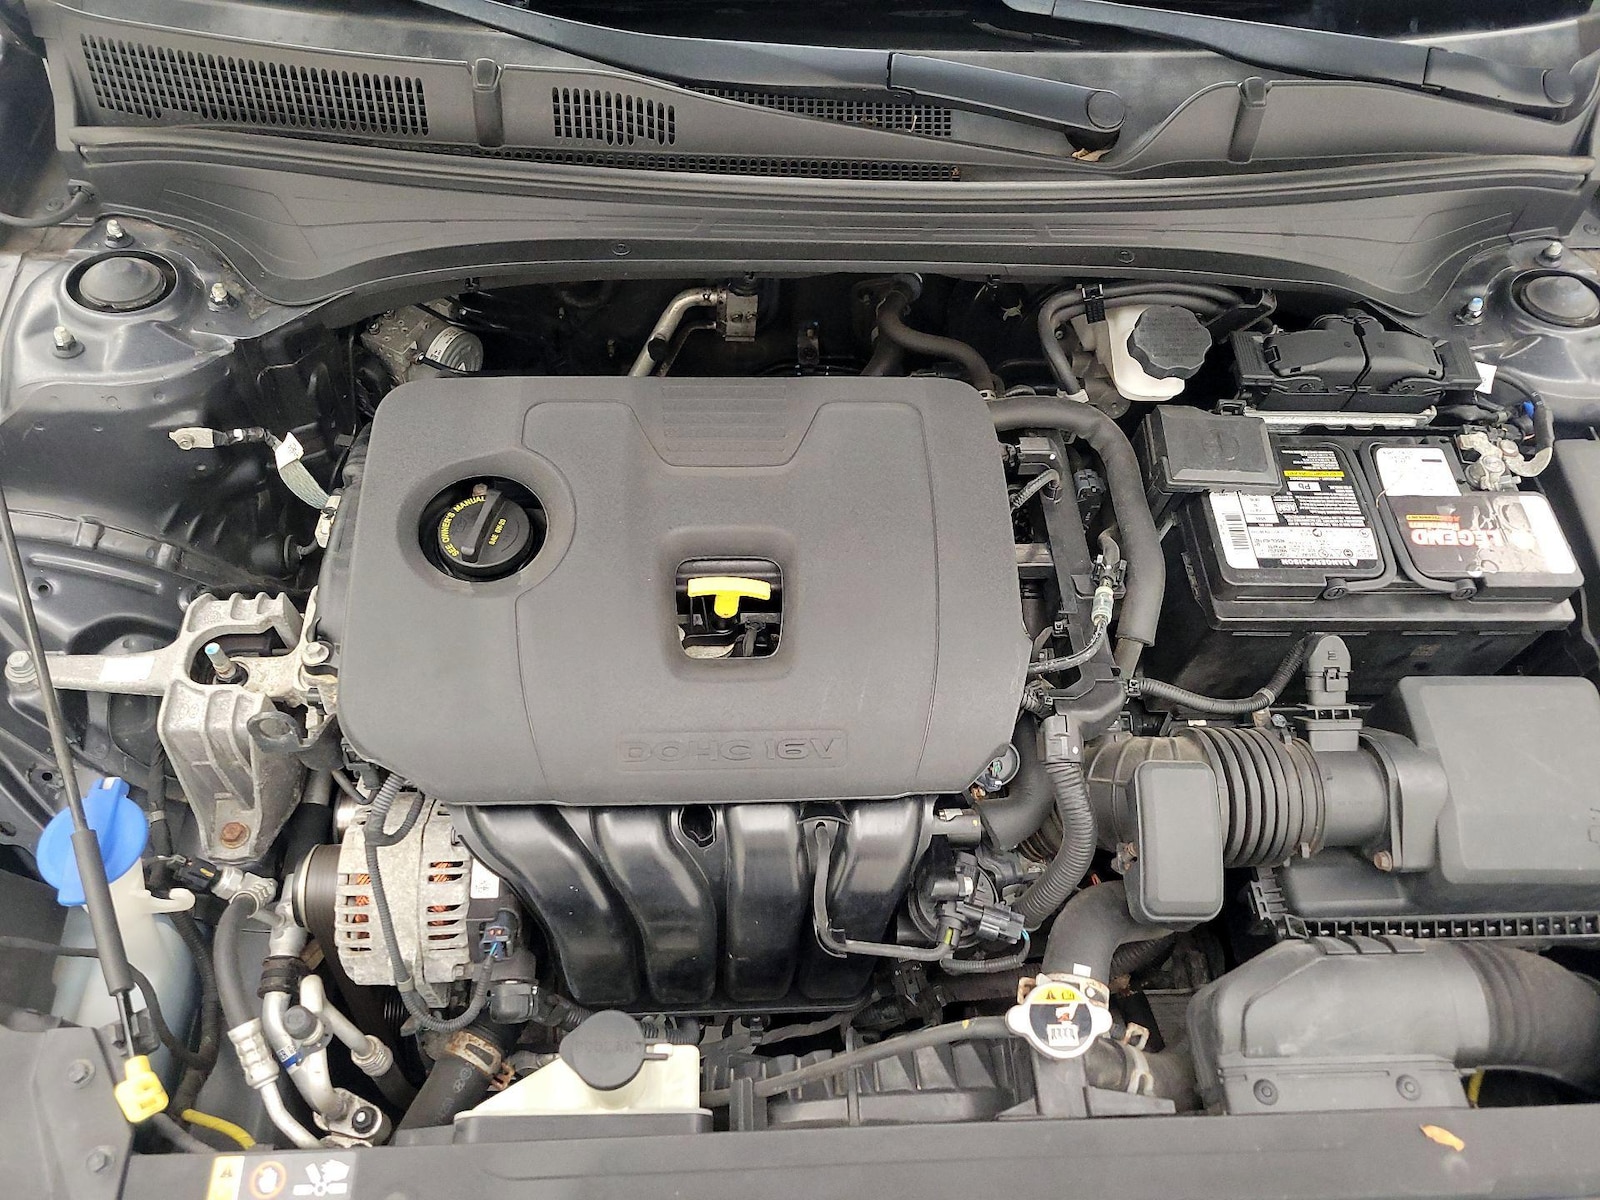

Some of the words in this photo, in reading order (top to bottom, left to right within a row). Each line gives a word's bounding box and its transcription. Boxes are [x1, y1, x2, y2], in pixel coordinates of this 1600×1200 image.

[453, 496, 486, 512] MANUAL
[441, 512, 455, 543] OWNER'S
[1411, 529, 1503, 547] LEGEND
[445, 543, 459, 557] SEE
[622, 740, 752, 762] DOHC
[765, 737, 842, 760] 16V
